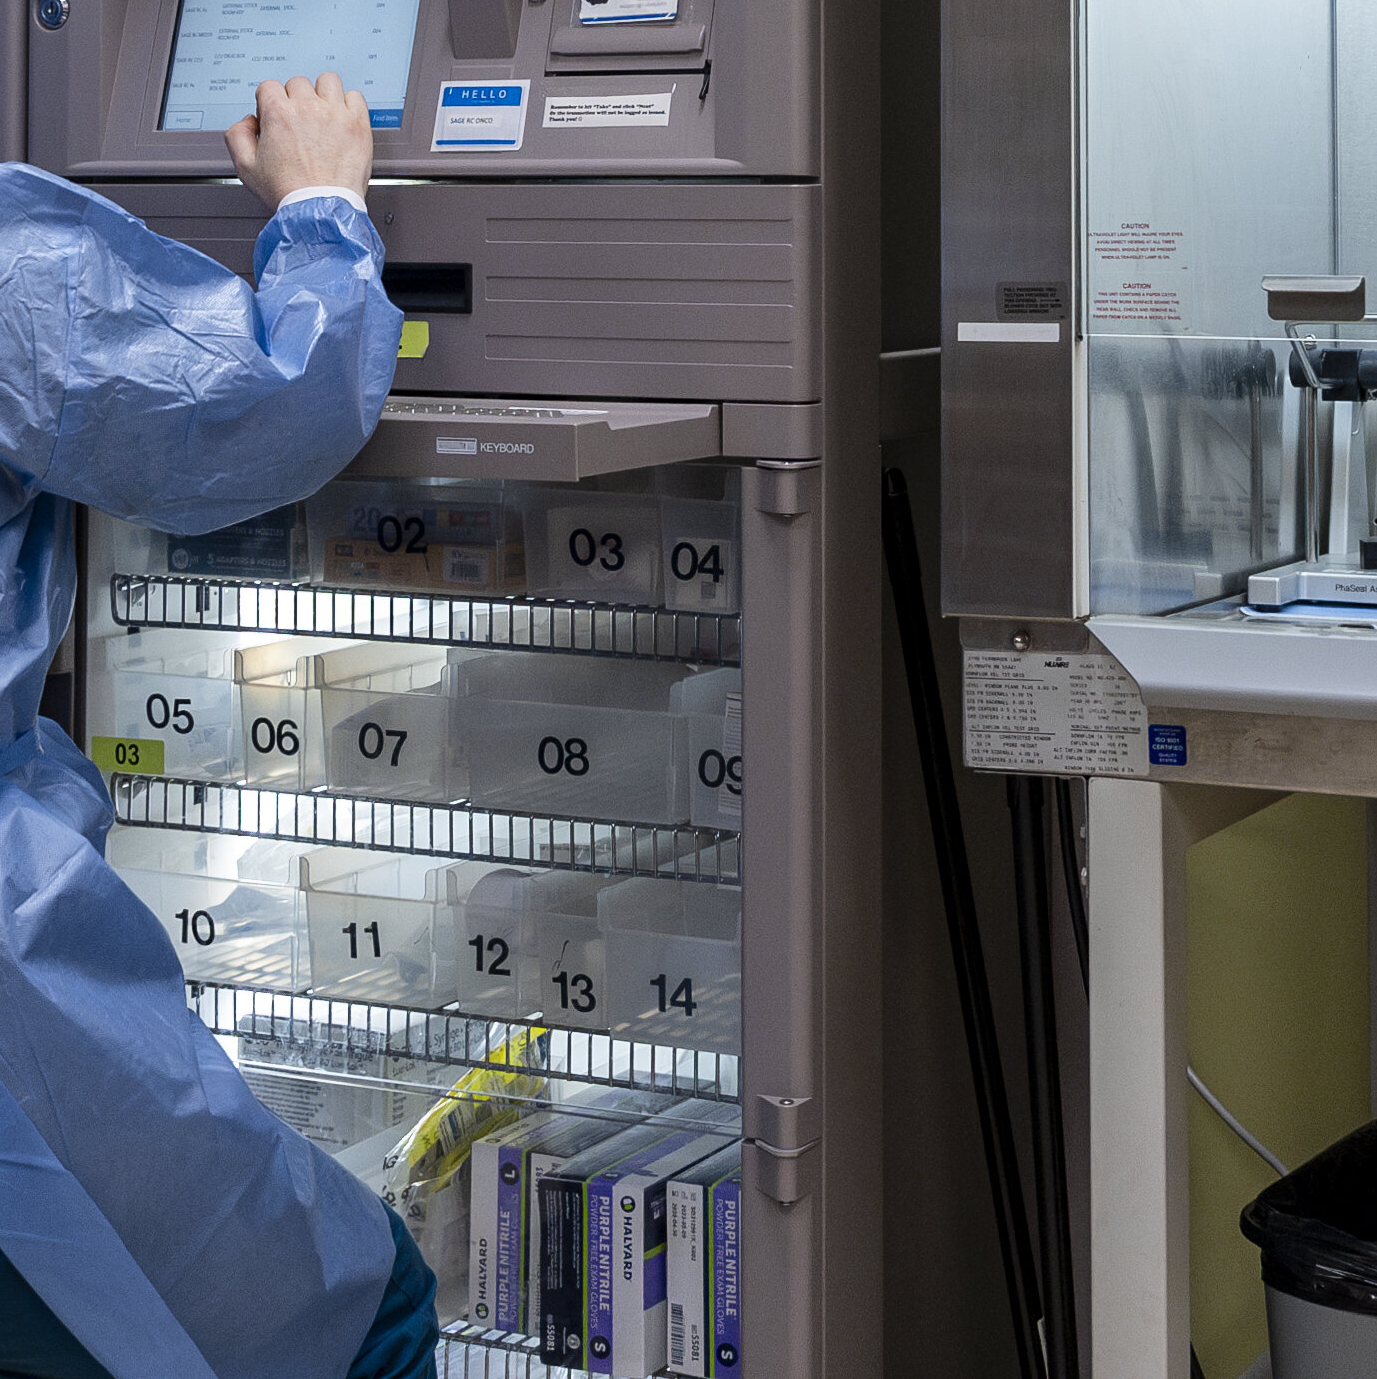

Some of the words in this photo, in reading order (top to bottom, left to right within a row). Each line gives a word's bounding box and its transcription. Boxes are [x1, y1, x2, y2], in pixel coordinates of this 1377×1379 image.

[461, 89, 507, 100] HELLO
[480, 443, 534, 454] KEYBOARD
[377, 516, 427, 554] 02
[569, 528, 625, 571] 03
[671, 542, 724, 583] 04
[1335, 583, 1367, 592] PhaSeal
[146, 693, 195, 735] 05
[115, 743, 140, 766] 03
[251, 717, 300, 756] 06
[358, 722, 408, 767] 07
[538, 736, 590, 776] 08
[175, 908, 215, 946] 10
[342, 921, 381, 959] 11
[468, 934, 511, 976] 12
[552, 971, 596, 1013] 13
[650, 974, 697, 1016] 14
[504, 1169, 516, 1179] L
[500, 1210, 511, 1263] NITRILE
[599, 1196, 610, 1254] PURPLE
[725, 1200, 736, 1259] PURPLE
[478, 1238, 488, 1300] HALYARD
[623, 1216, 633, 1281] HALYARD
[498, 1263, 510, 1321] PURPLE
[599, 1256, 610, 1312] NITRILE
[726, 1261, 737, 1317] NITRILE
[595, 1343, 606, 1353] S
[721, 1351, 733, 1360] S
